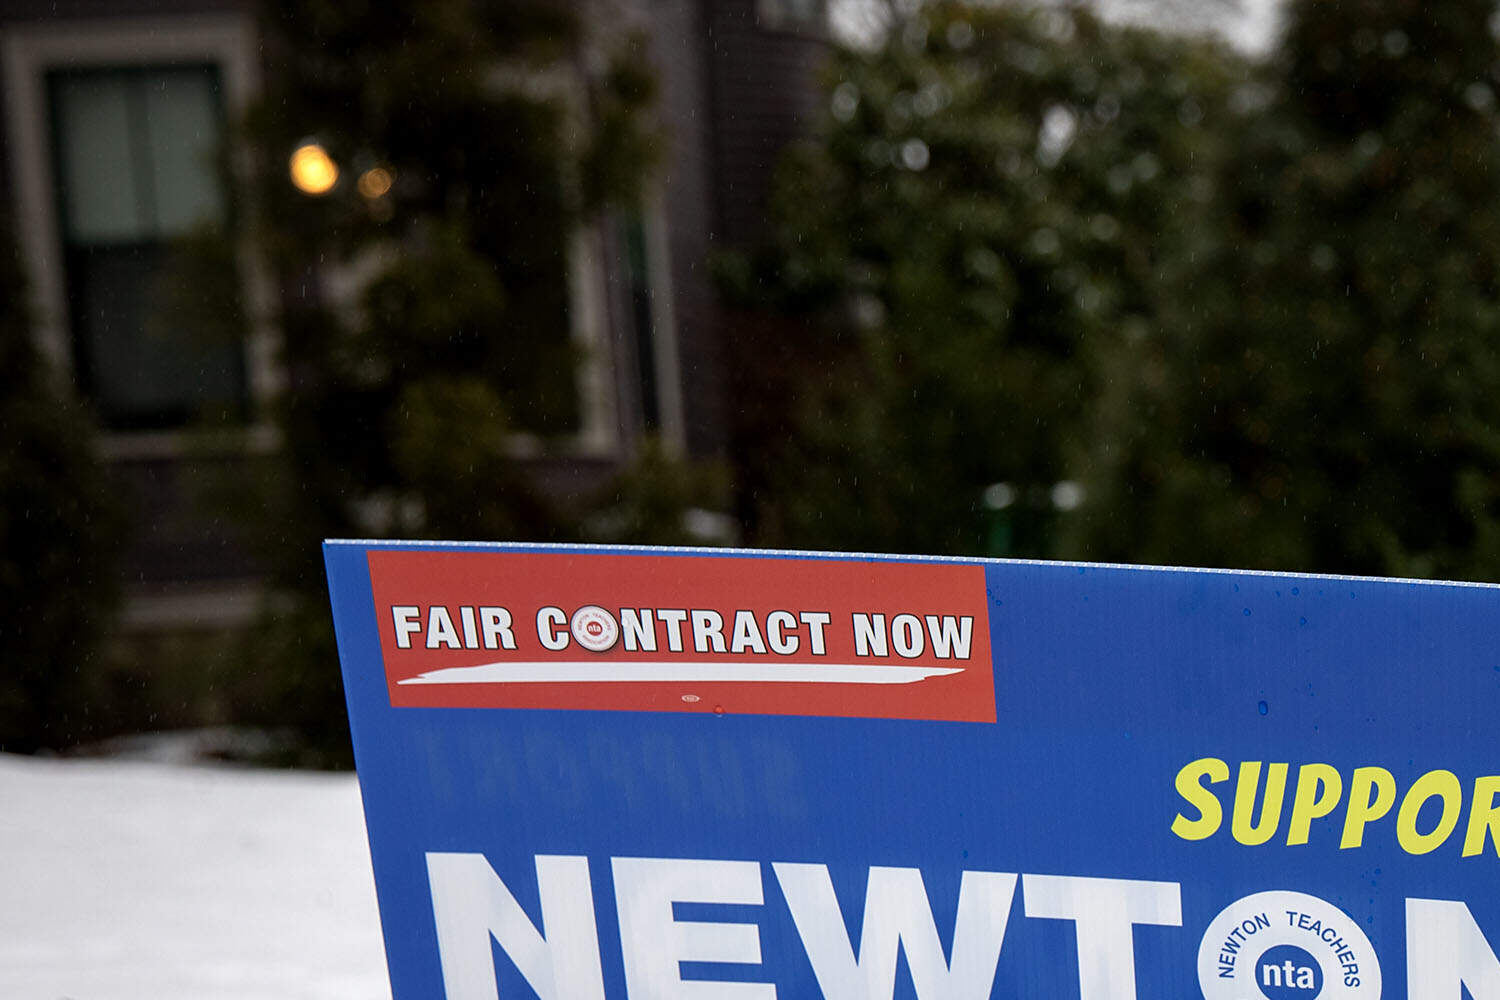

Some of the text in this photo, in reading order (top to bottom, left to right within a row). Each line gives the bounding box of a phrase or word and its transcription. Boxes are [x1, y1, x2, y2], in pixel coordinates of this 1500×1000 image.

[390, 604, 977, 660] FAIR CONTRACT NOW
[1218, 911, 1361, 988] NEWTON TEACHERS
[1262, 960, 1315, 990] nta
